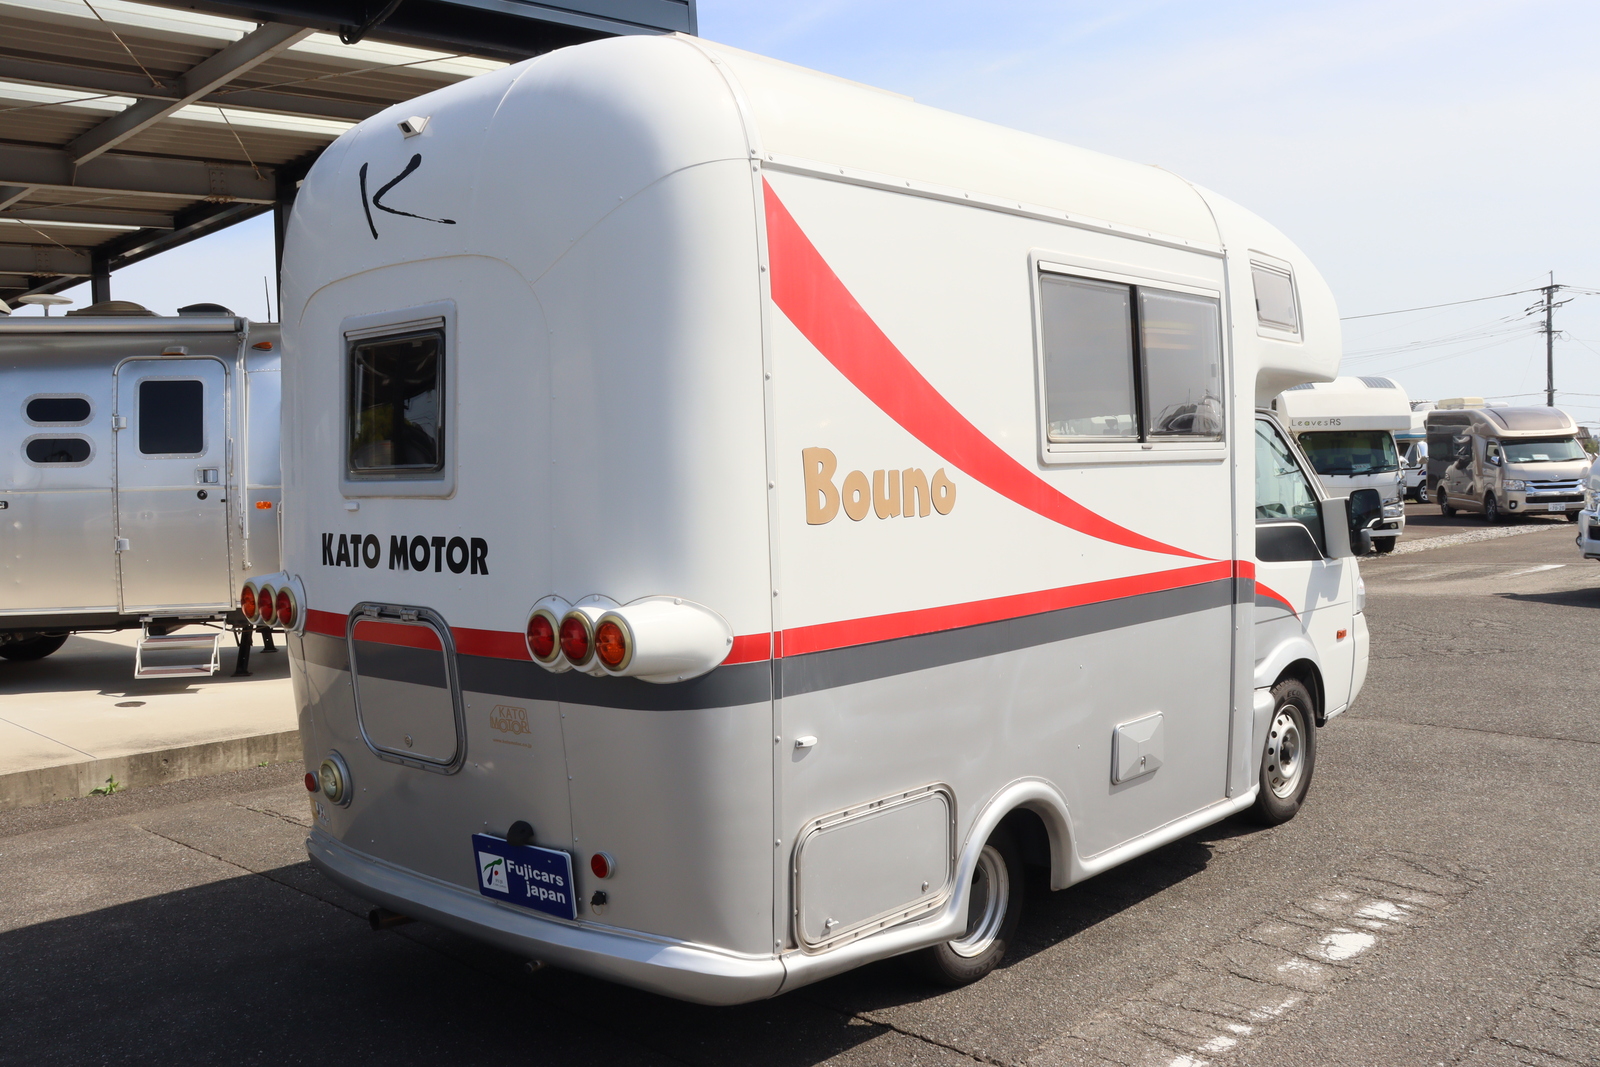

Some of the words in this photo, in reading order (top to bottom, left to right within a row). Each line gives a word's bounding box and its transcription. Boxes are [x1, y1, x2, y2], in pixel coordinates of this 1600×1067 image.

[359, 153, 456, 240] K
[802, 446, 957, 526] Bouno
[322, 532, 381, 569] KATO
[388, 534, 489, 576] MOTOR
[490, 716, 529, 735] MOTOR
[498, 706, 526, 721] KATO
[506, 859, 565, 888] Fujicars
[526, 881, 566, 904] japan
